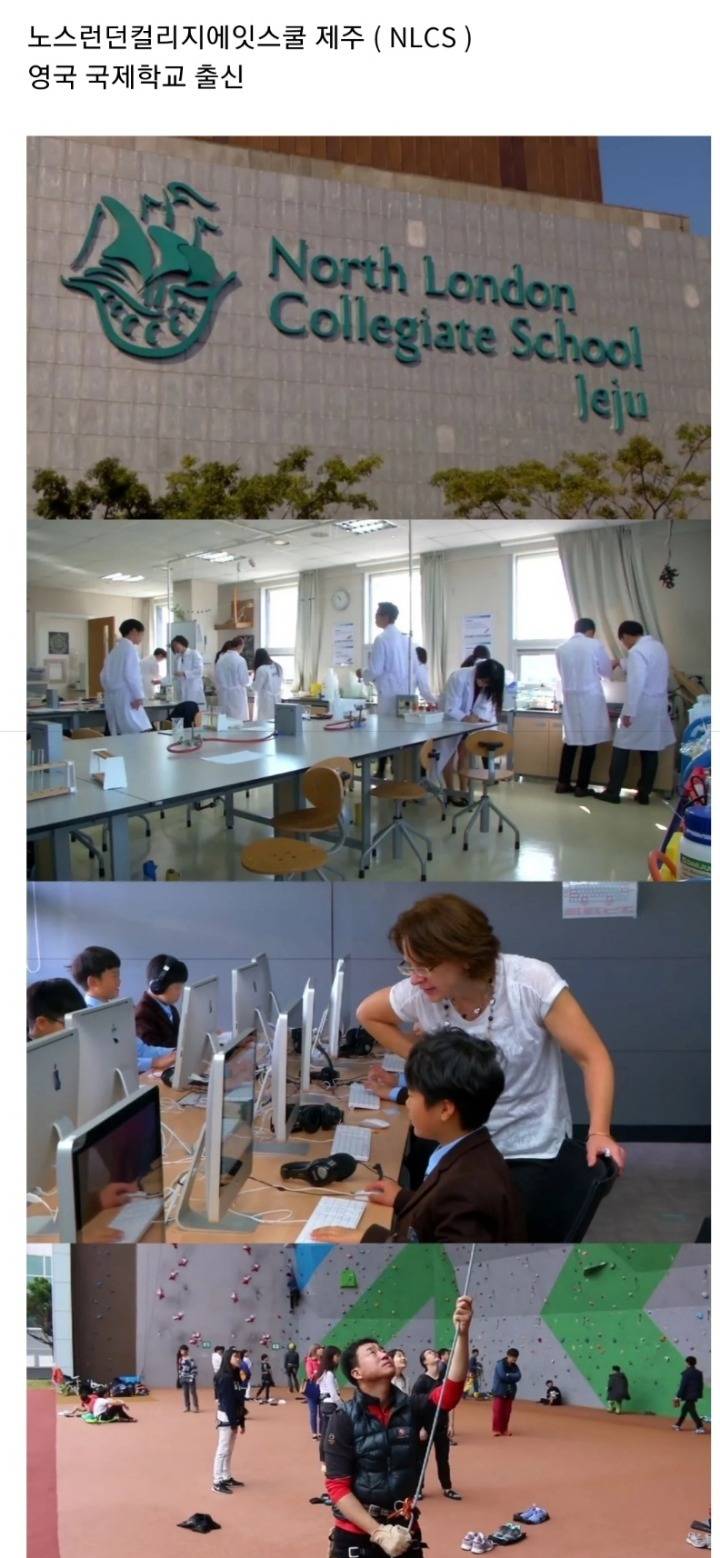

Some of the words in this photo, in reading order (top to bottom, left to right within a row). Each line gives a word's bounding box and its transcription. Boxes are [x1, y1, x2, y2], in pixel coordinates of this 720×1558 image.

[268, 235, 408, 294] North
[422, 255, 577, 315] London
[269, 291, 497, 366] Collegiate
[510, 317, 644, 371] School
[574, 372, 650, 434] Jeju
